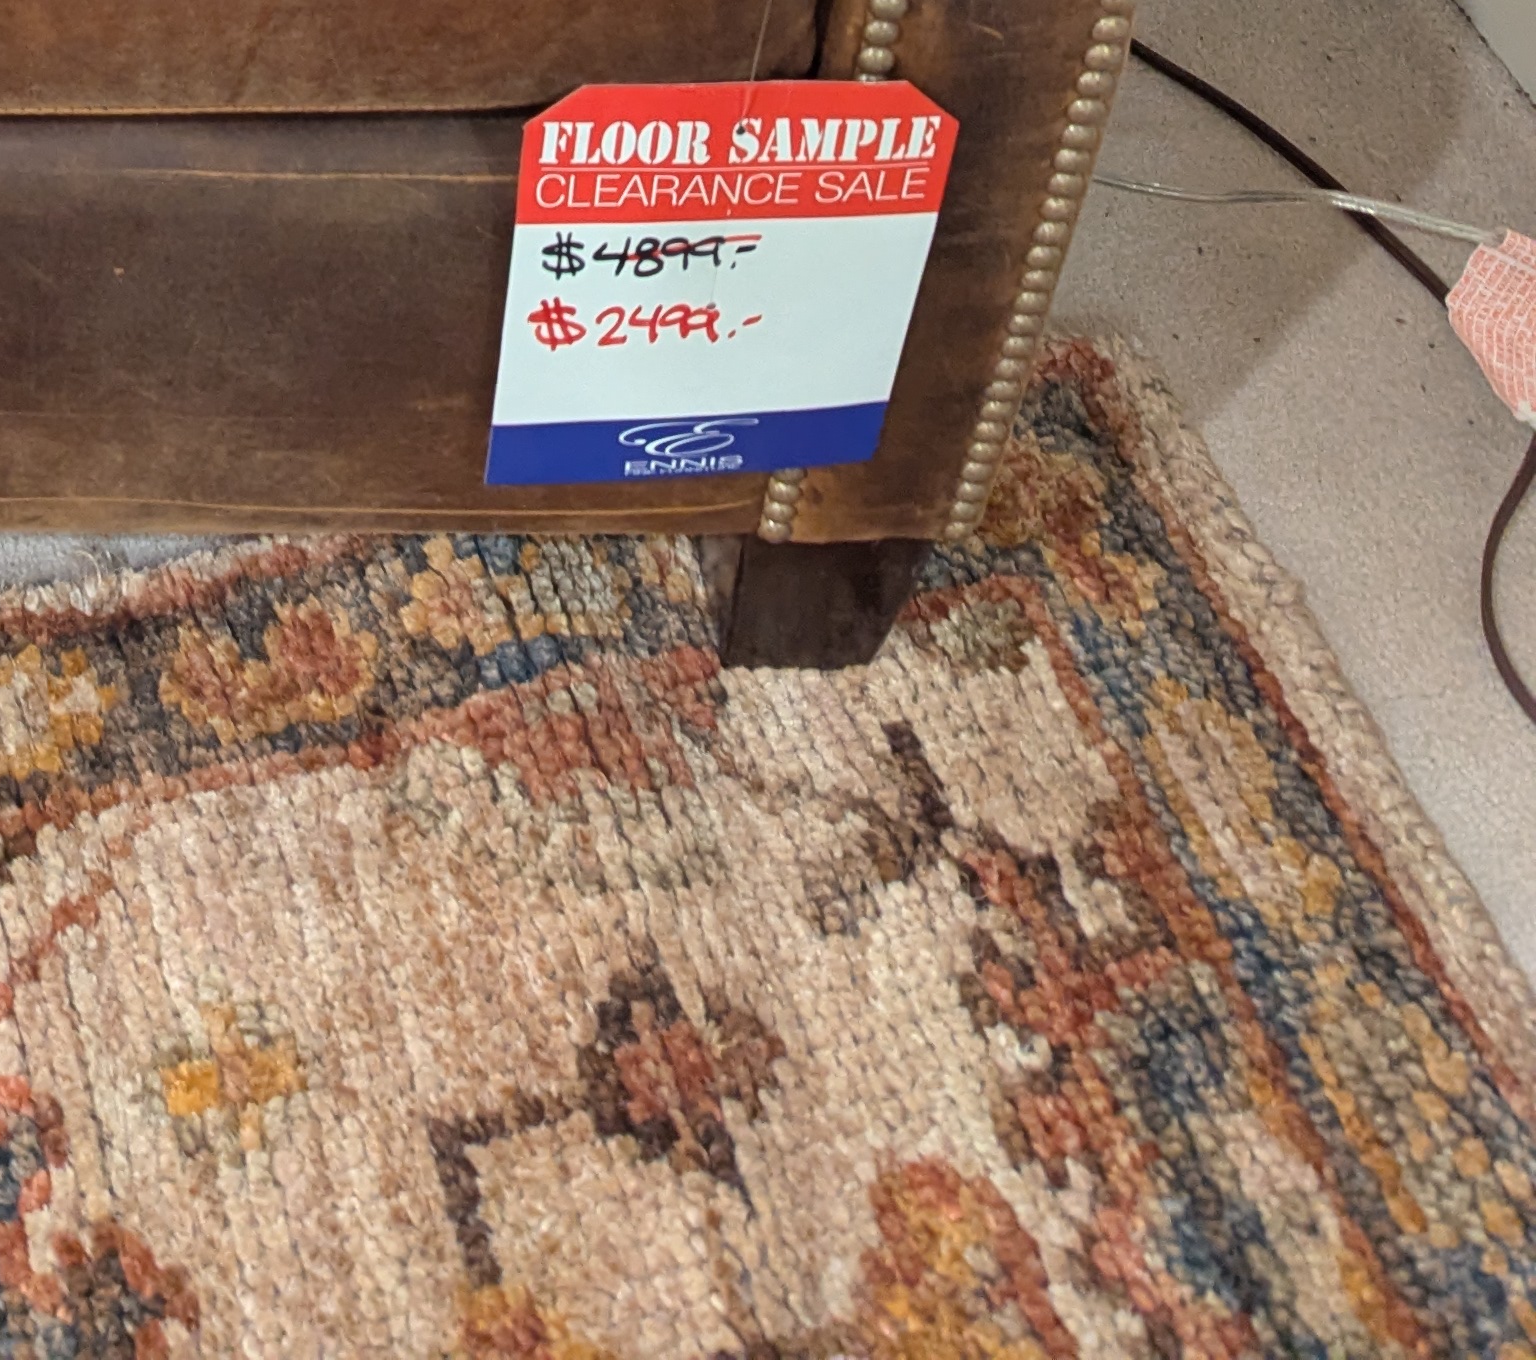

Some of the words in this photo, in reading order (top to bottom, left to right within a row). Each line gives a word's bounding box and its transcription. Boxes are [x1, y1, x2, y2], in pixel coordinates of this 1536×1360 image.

[538, 120, 712, 165] FLOOR
[728, 115, 942, 165] SAMPLE
[536, 172, 803, 208] CLEARANCE
[814, 167, 930, 203] SALE
